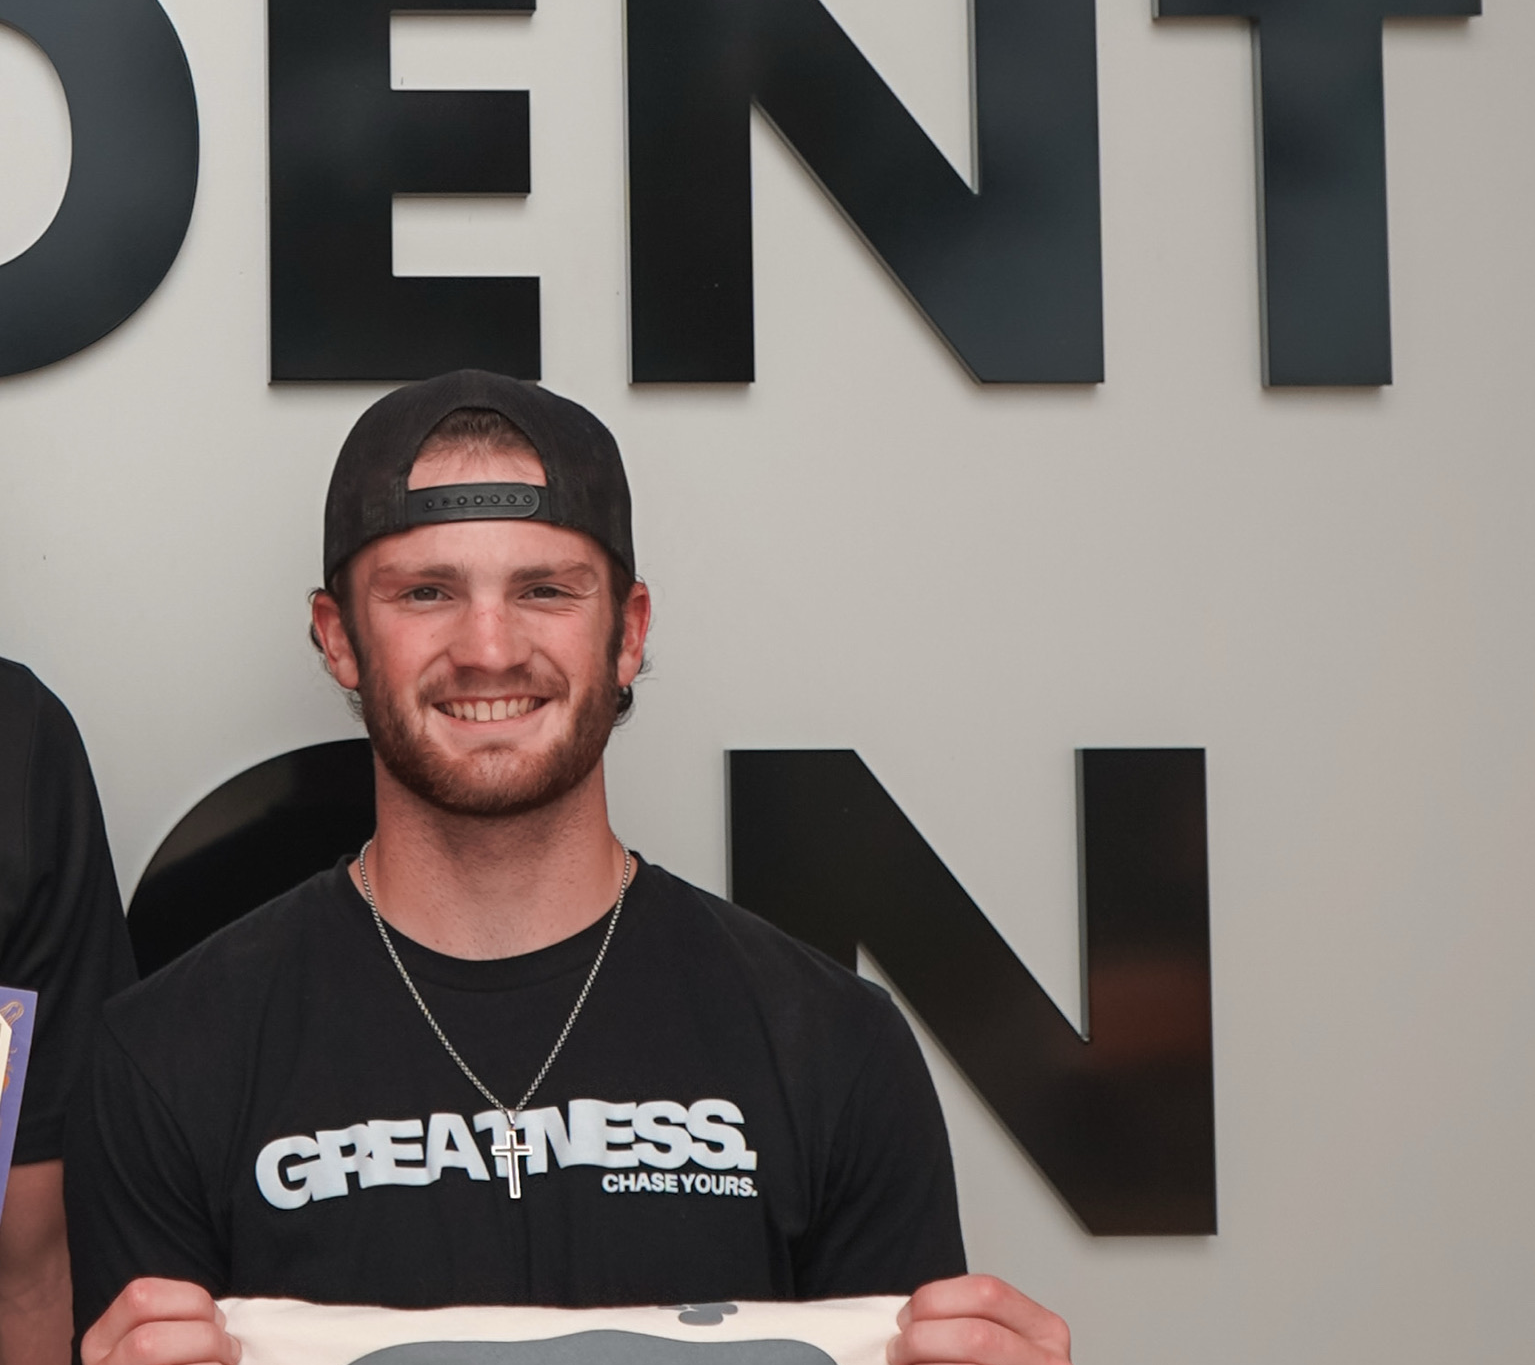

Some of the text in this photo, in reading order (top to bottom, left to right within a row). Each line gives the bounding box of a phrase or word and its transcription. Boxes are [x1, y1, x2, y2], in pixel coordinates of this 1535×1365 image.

[254, 1098, 757, 1211] GREATNESS.
[602, 1172, 758, 1197] CHASE YOURS.
